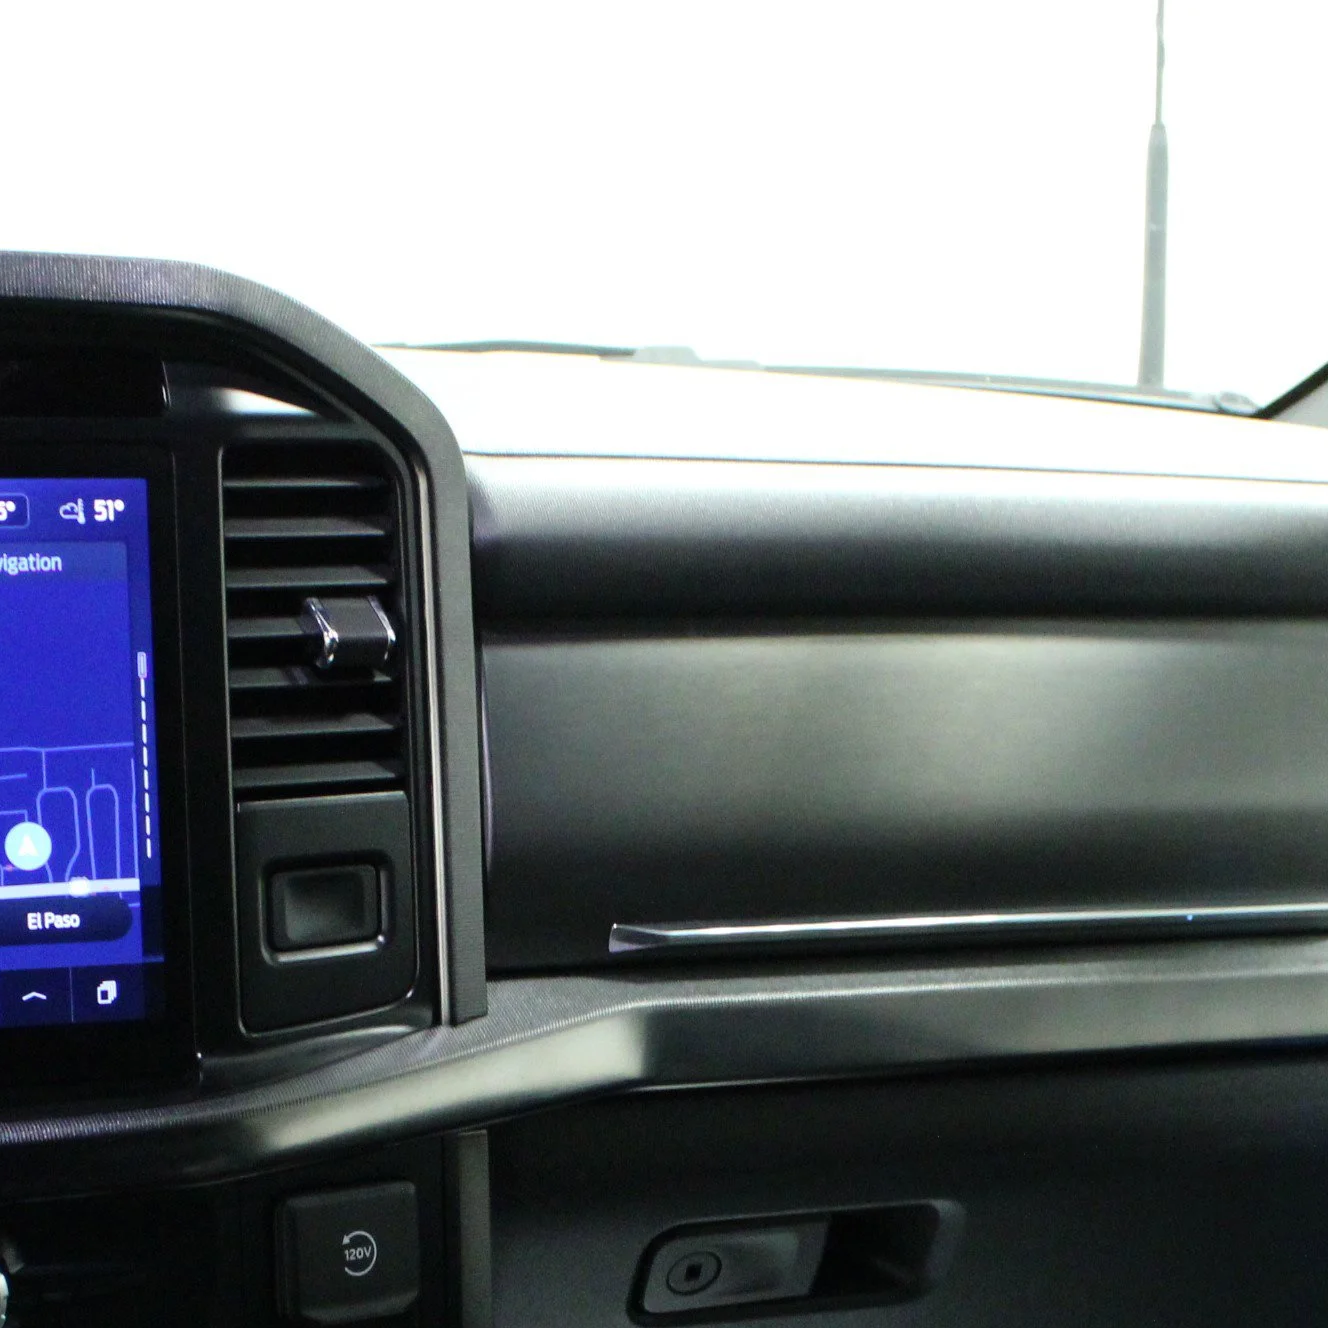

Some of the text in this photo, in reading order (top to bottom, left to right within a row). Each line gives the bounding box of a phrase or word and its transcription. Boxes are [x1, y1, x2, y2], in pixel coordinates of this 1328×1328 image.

[93, 498, 126, 523] 51°
[27, 911, 81, 930] El Paso
[345, 1246, 373, 1261] 120V
